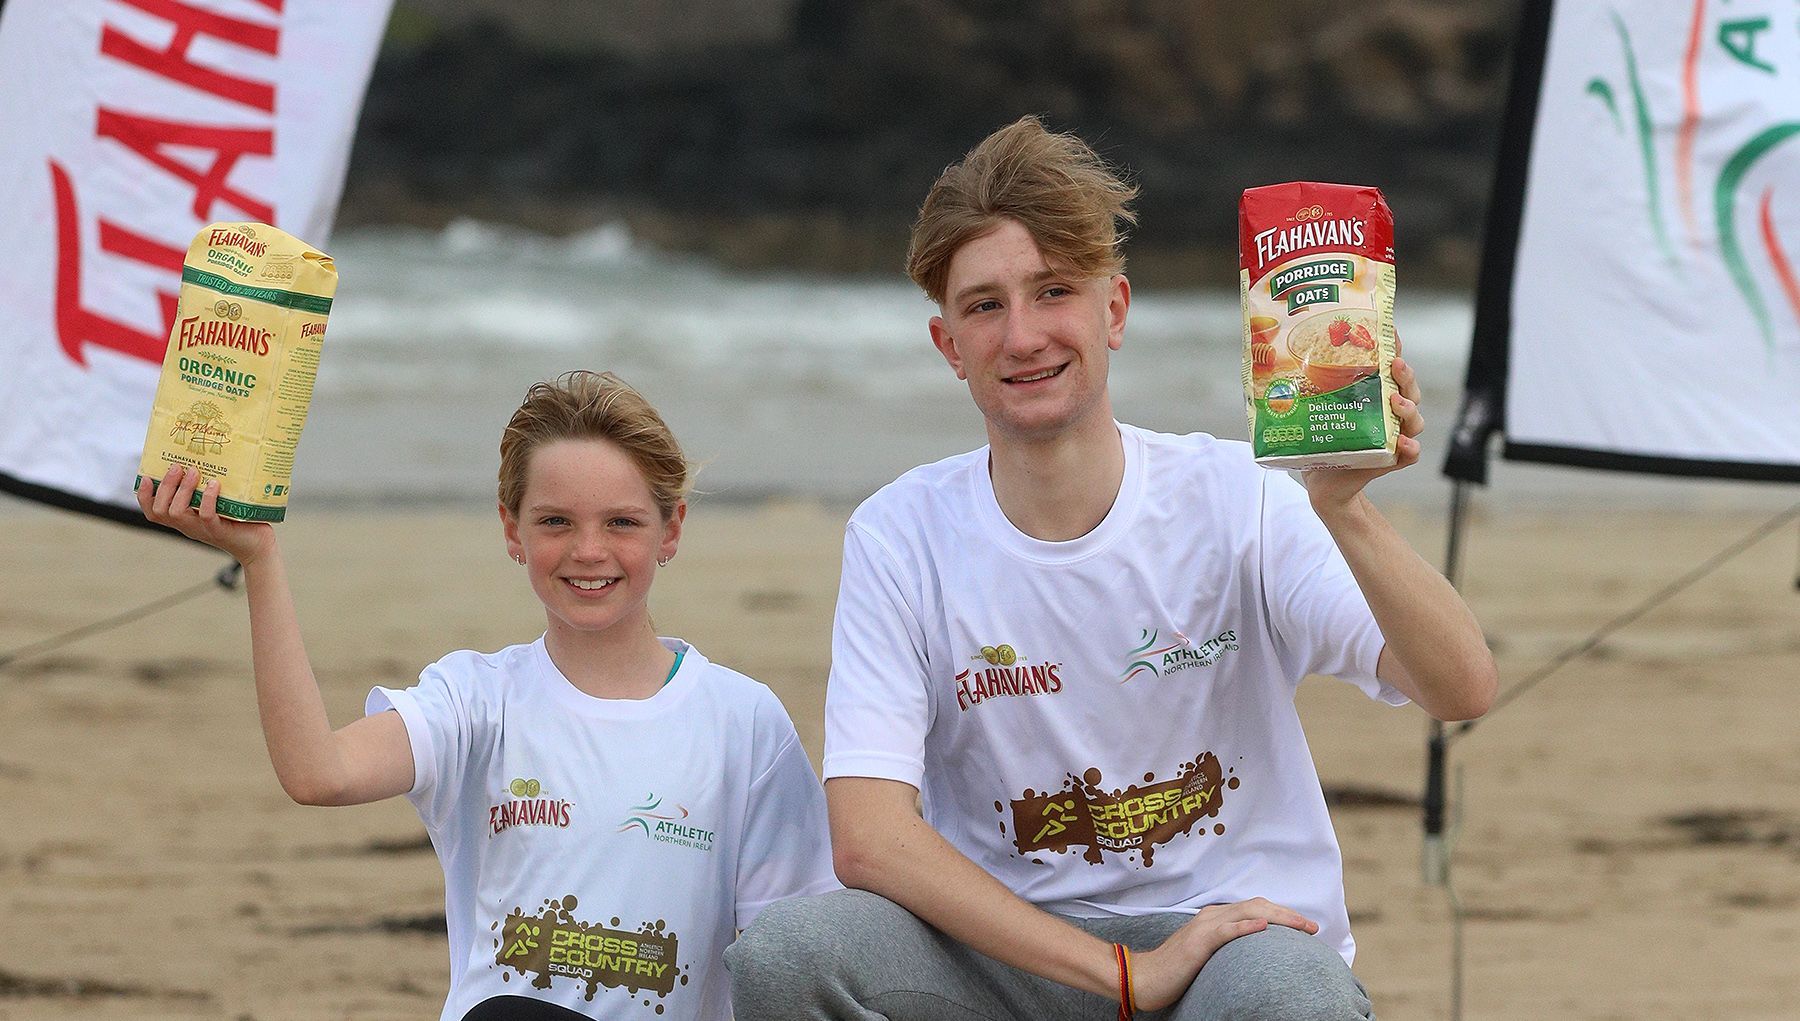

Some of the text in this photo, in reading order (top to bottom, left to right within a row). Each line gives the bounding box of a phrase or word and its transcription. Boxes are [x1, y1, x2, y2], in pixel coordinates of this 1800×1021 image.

[48, 0, 285, 373] FLAH
[208, 228, 268, 258] FLAHAVAN'S
[1254, 217, 1364, 270] FLAHAVAN'S
[207, 249, 254, 274] ORGANIC
[196, 273, 278, 301] TRUSTED FOR 200 YEARS
[1275, 263, 1348, 289] PORRIDGE
[1295, 287, 1329, 305] OATS
[178, 315, 272, 357] FLAHAVAN'S
[178, 356, 257, 389] ORGANIC
[181, 373, 224, 391] PORRIDGE
[225, 385, 250, 398] OATS
[1308, 400, 1363, 412] Deliciously
[1309, 413, 1345, 422] creamy
[1310, 421, 1356, 432] and tasty
[1311, 434, 1324, 444] 1kg
[167, 452, 196, 464] FLAHAVAN
[202, 462, 217, 470] SONS
[1162, 630, 1237, 667] ATHLETICS
[1164, 659, 1213, 676] NORTHERN
[955, 661, 1063, 712] FLAHAVAN'S
[1087, 788, 1183, 823] CROSS
[1092, 784, 1216, 839] COUNTRY
[653, 833, 713, 852] NORTHERN IRELA
[655, 820, 714, 843] ATHLETIC
[1096, 835, 1143, 849] SQUAD
[551, 929, 638, 957] CROSS
[548, 963, 593, 978] SQUAD
[549, 947, 668, 978] COUNTRY
